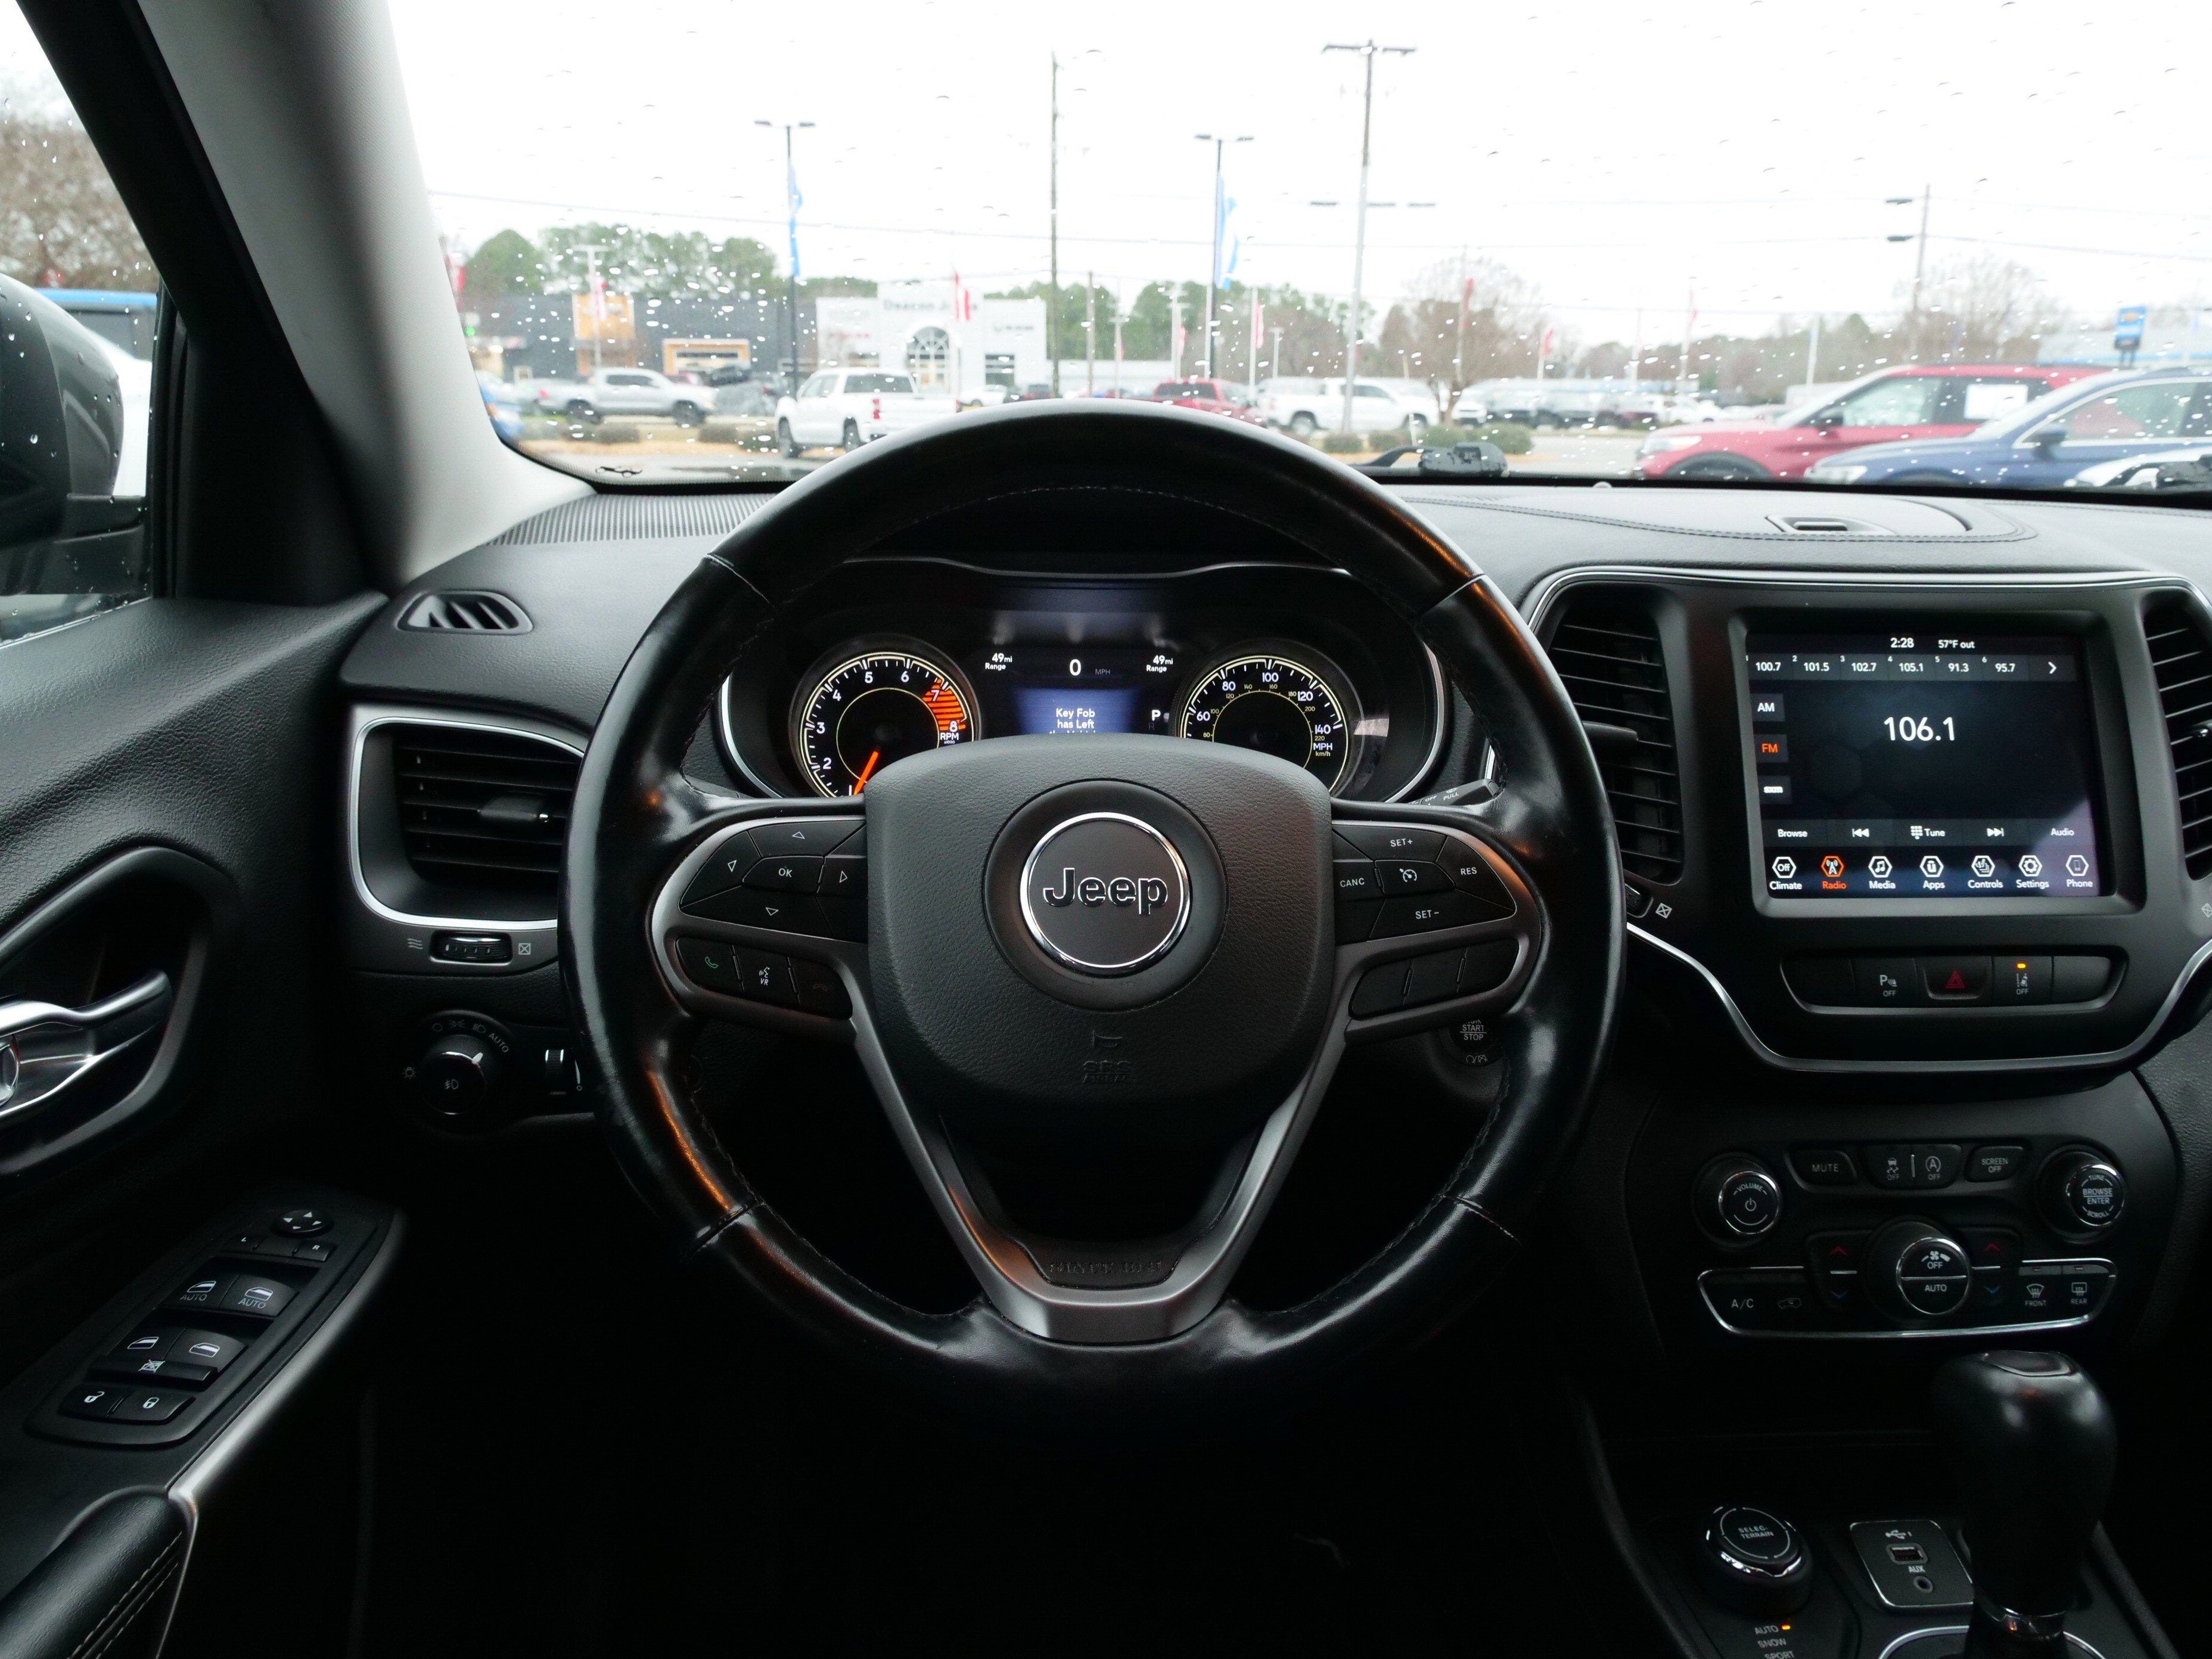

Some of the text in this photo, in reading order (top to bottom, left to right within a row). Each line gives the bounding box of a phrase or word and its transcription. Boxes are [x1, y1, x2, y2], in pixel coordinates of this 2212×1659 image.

[1890, 637, 1914, 648] 2:28
[1070, 658, 1082, 676] 0
[1146, 664, 1167, 673] Range
[1756, 662, 1781, 671] 100.7
[1804, 662, 1829, 672] 101.5
[1851, 663, 1877, 672] 102.7
[1899, 663, 1924, 672] 105.1
[1948, 663, 1969, 672] 91.3
[1995, 663, 2015, 672] 95.7
[865, 672, 873, 684] 5
[901, 671, 909, 682] 6
[1262, 672, 1279, 683] 100
[1222, 681, 1236, 691] 80
[832, 689, 841, 701] 4
[931, 690, 940, 701] 7
[1297, 691, 1313, 701] 120
[1757, 702, 1775, 712] AM
[1056, 708, 1095, 719] Key Fob
[1151, 710, 1161, 720] P
[1197, 712, 1210, 721] 60
[816, 722, 825, 734] 3
[949, 721, 958, 732] 8
[1057, 719, 1094, 729] has Left
[1884, 716, 1956, 741] 106.1
[1315, 725, 1331, 734] 140
[1761, 744, 1779, 753] FM
[823, 757, 831, 769] 2
[1778, 829, 1807, 837] Browse
[1924, 828, 1945, 837] Tune
[2051, 828, 2074, 836] Audio
[1460, 866, 1477, 876] RES
[1777, 863, 1791, 872] Off
[778, 868, 792, 878] OK
[1340, 877, 1365, 887] CANC
[1769, 881, 1802, 890] Climate
[1822, 881, 1847, 889] Radio
[1869, 881, 1896, 889] Media
[1923, 881, 1945, 890] Apps
[1968, 880, 2003, 888] Controls
[2016, 880, 2049, 889] Settings
[1043, 868, 1168, 915] Jeep
[760, 977, 769, 986] VR
[488, 1032, 509, 1054] AUTO
[1981, 1157, 2009, 1166] SCREEN
[1812, 1164, 1839, 1172] MUTE
[238, 1298, 266, 1309] AUTO
[1731, 1298, 1754, 1310] A/C
[1908, 1565, 1925, 1574] AUX
[1755, 1625, 1779, 1635] AUTO
[1758, 1638, 1787, 1648] SNOW
[1764, 1651, 1795, 1659] SPORT
